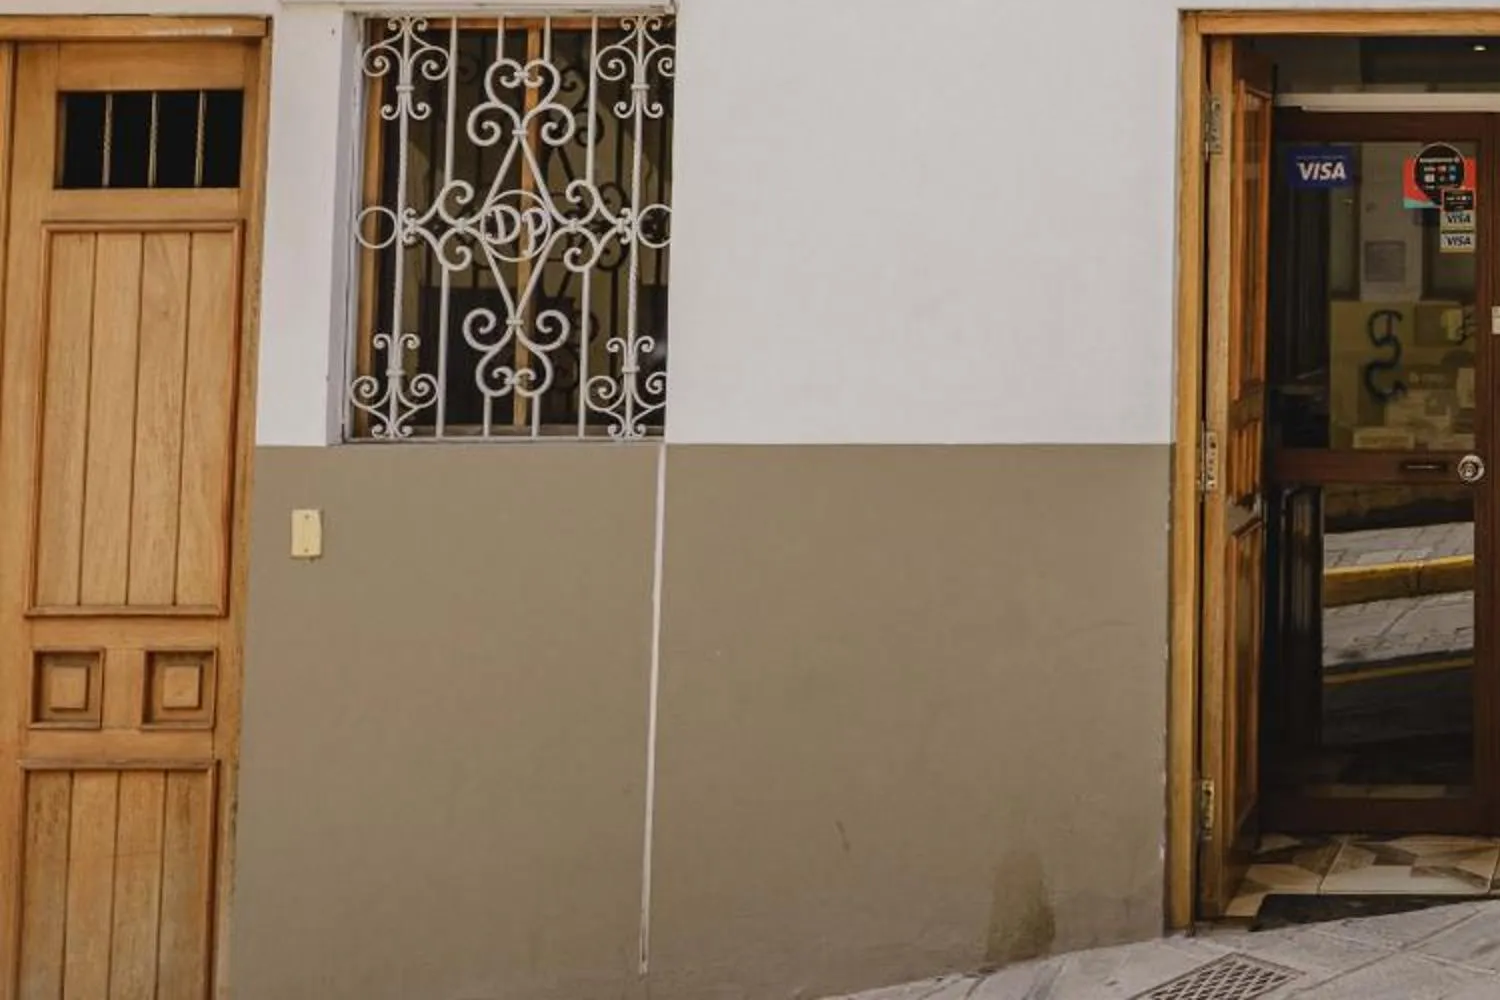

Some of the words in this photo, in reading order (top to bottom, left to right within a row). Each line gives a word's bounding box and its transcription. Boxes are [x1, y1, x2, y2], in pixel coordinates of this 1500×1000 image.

[1296, 161, 1347, 181] VISA
[1446, 214, 1471, 224] VISA
[1445, 235, 1471, 246] VISA
